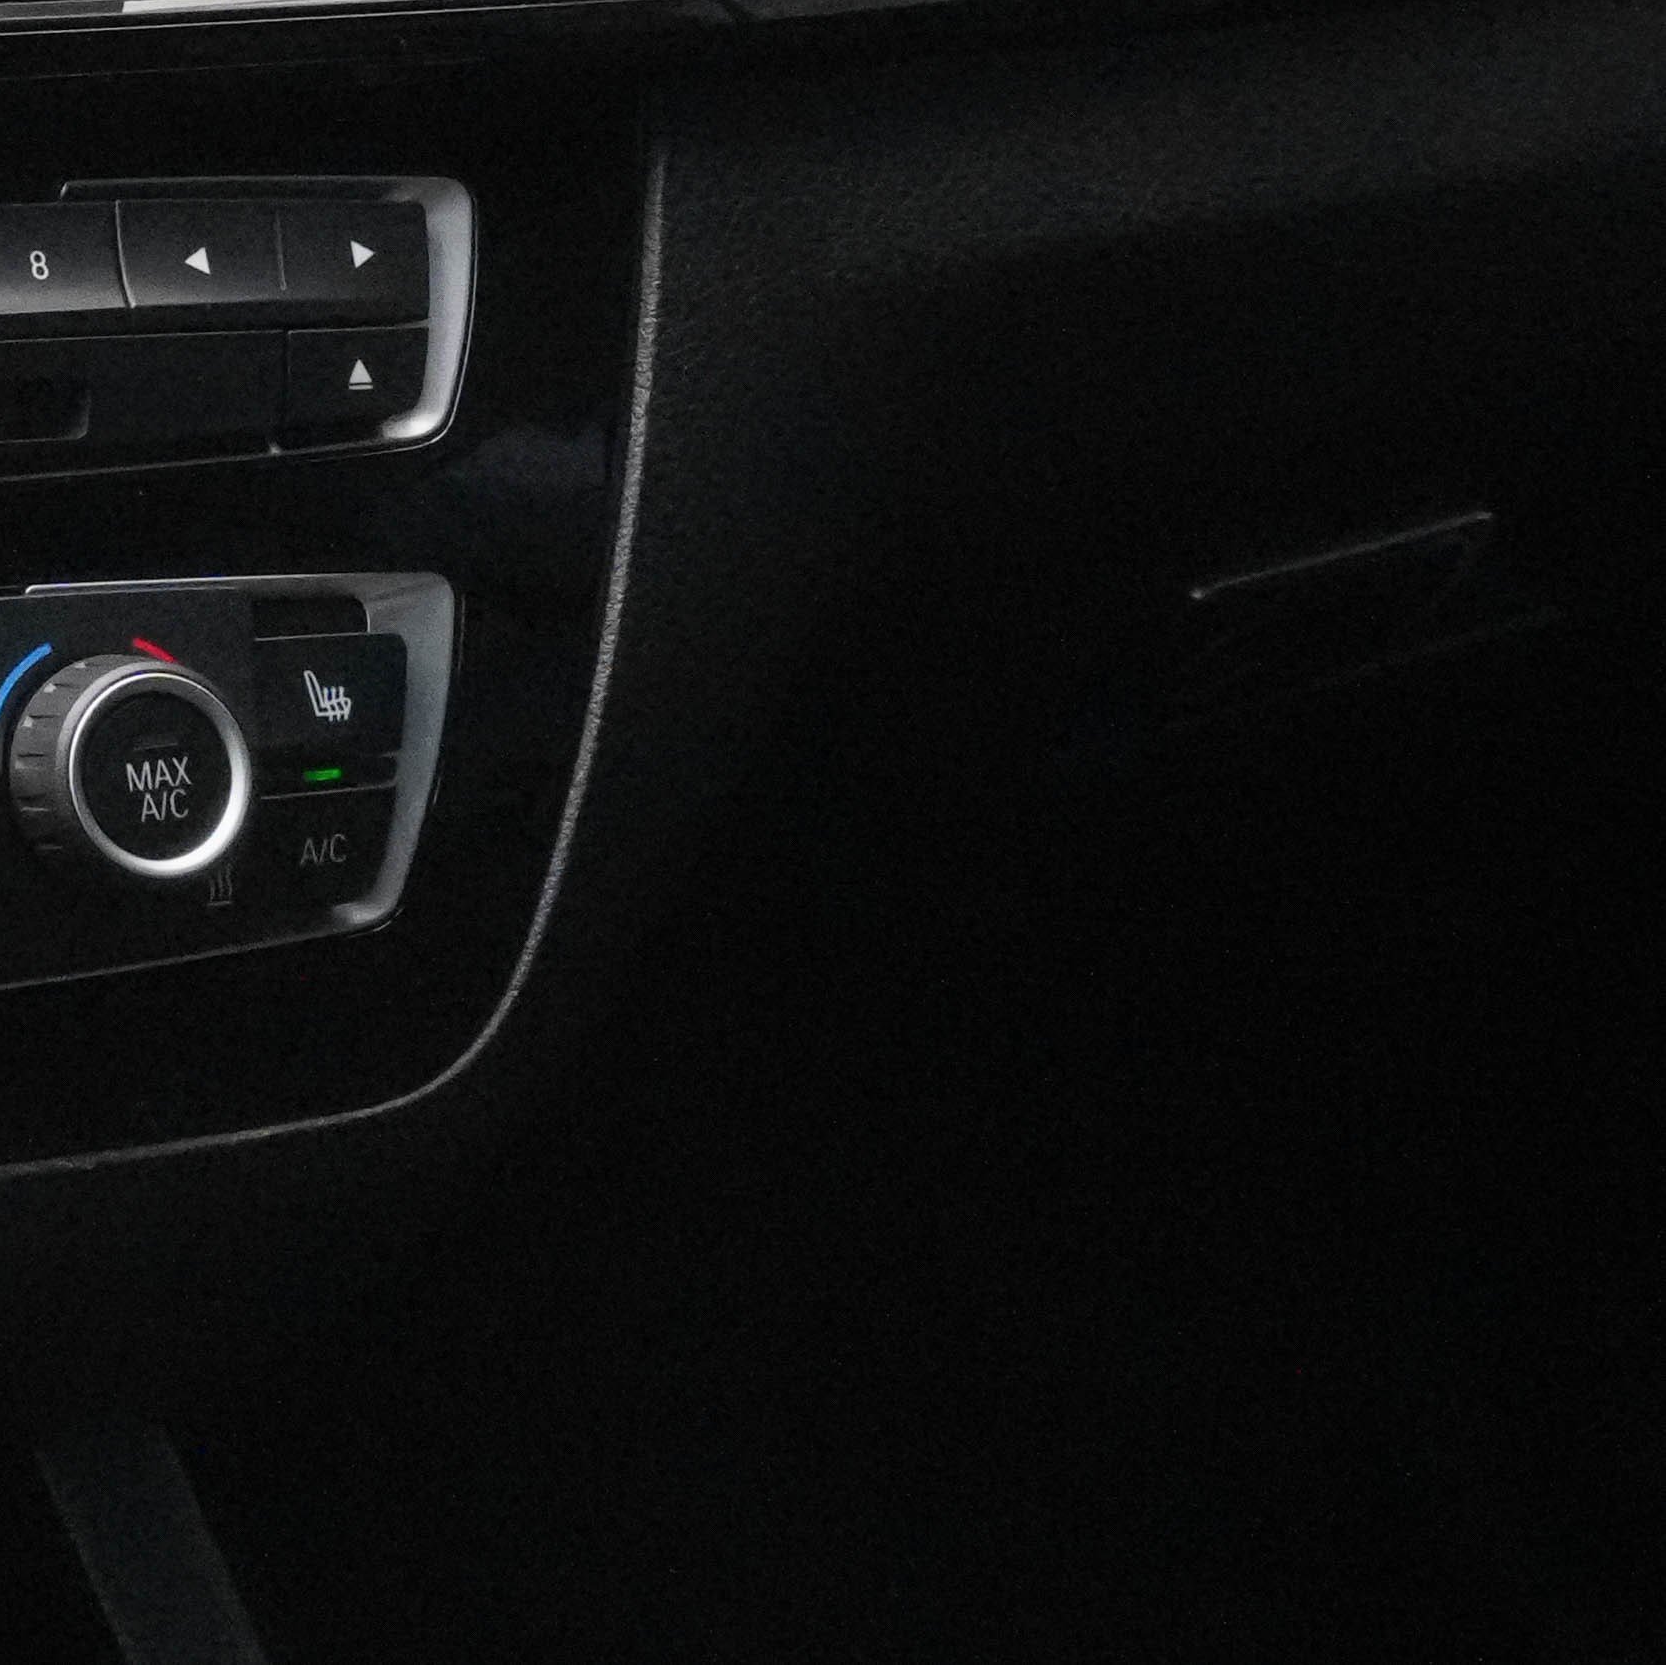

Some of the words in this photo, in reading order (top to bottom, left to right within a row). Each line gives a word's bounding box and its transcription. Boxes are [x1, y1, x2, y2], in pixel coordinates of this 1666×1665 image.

[30, 251, 49, 280] 8
[125, 756, 192, 791] MAX
[140, 788, 190, 823] A/C
[300, 834, 346, 865] A/C
